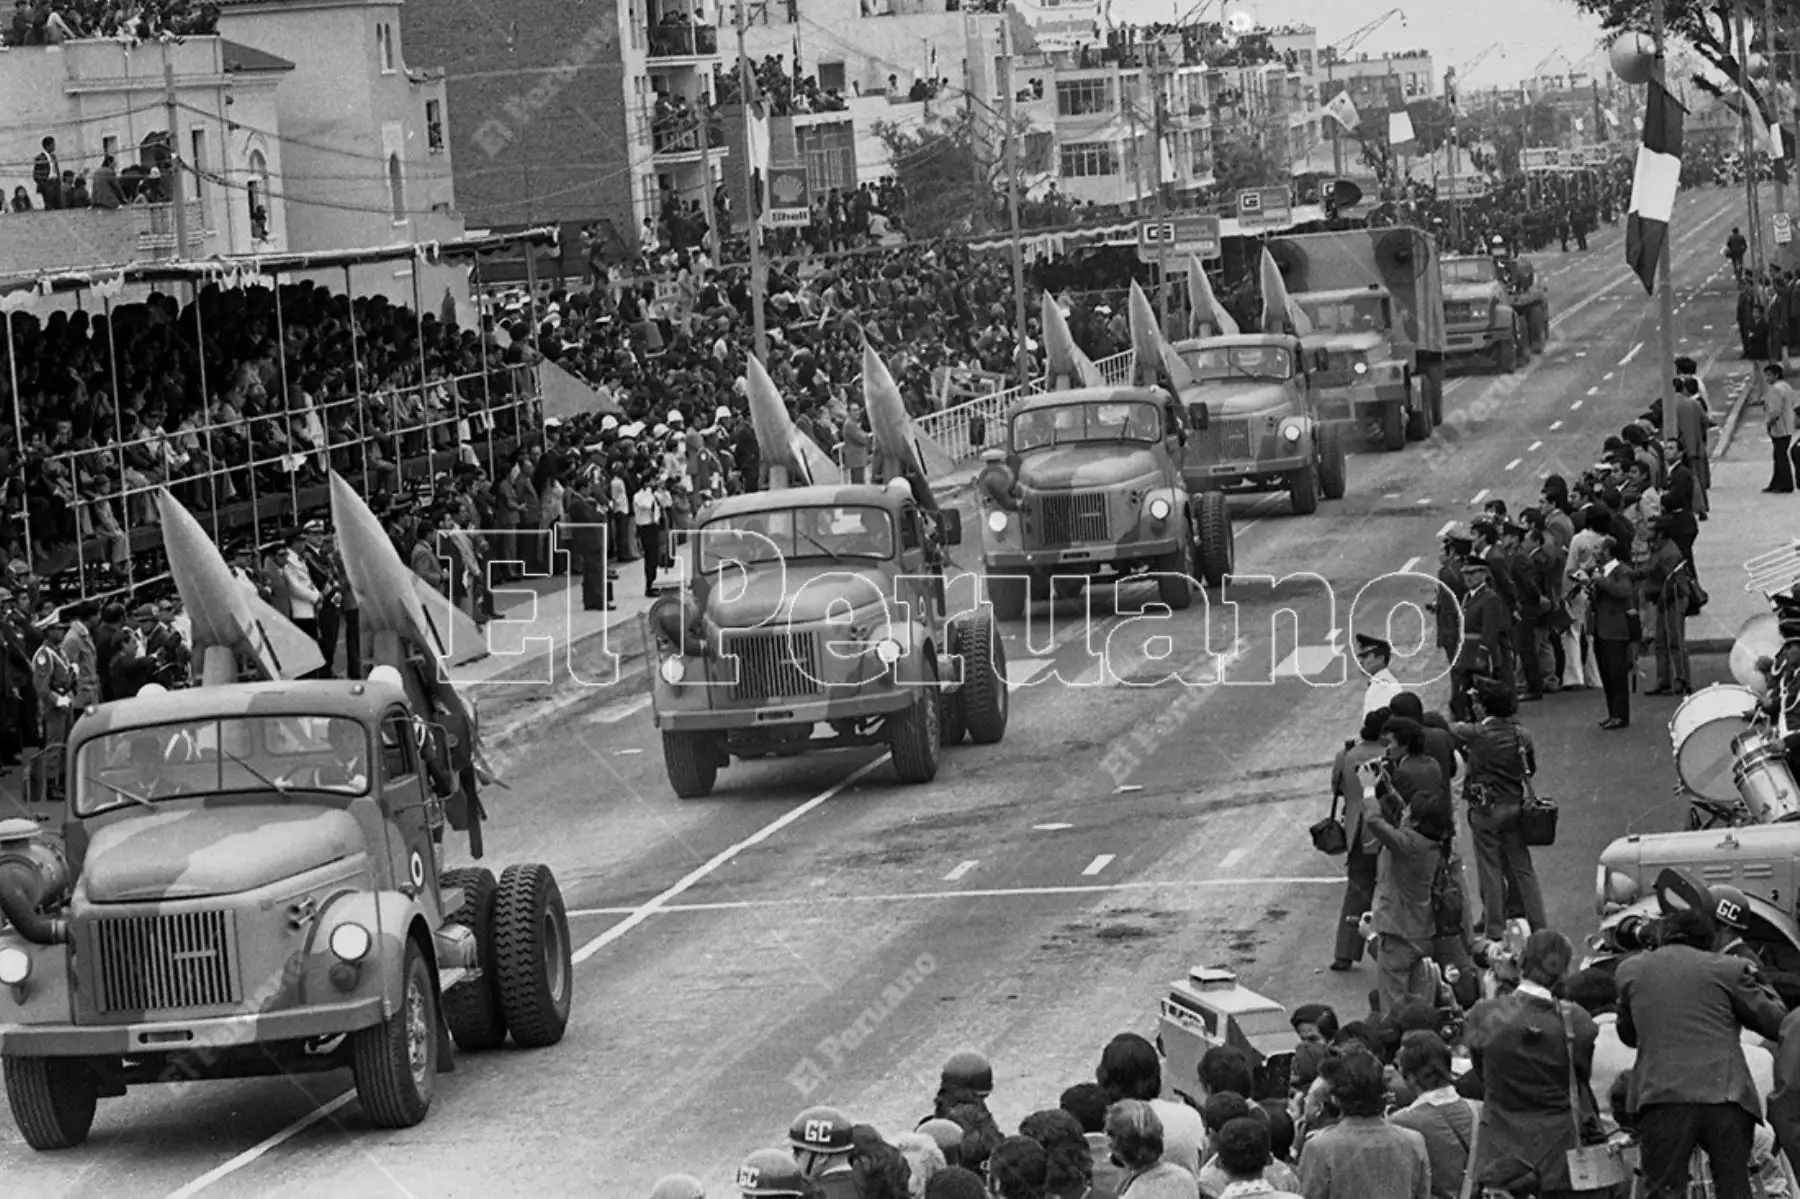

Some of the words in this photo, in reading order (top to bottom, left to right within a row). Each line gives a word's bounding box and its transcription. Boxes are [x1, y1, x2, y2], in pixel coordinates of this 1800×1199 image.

[771, 210, 808, 222] Shell
[1716, 898, 1741, 921] GC
[804, 1119, 833, 1143] GC
[738, 1165, 760, 1188] GC
